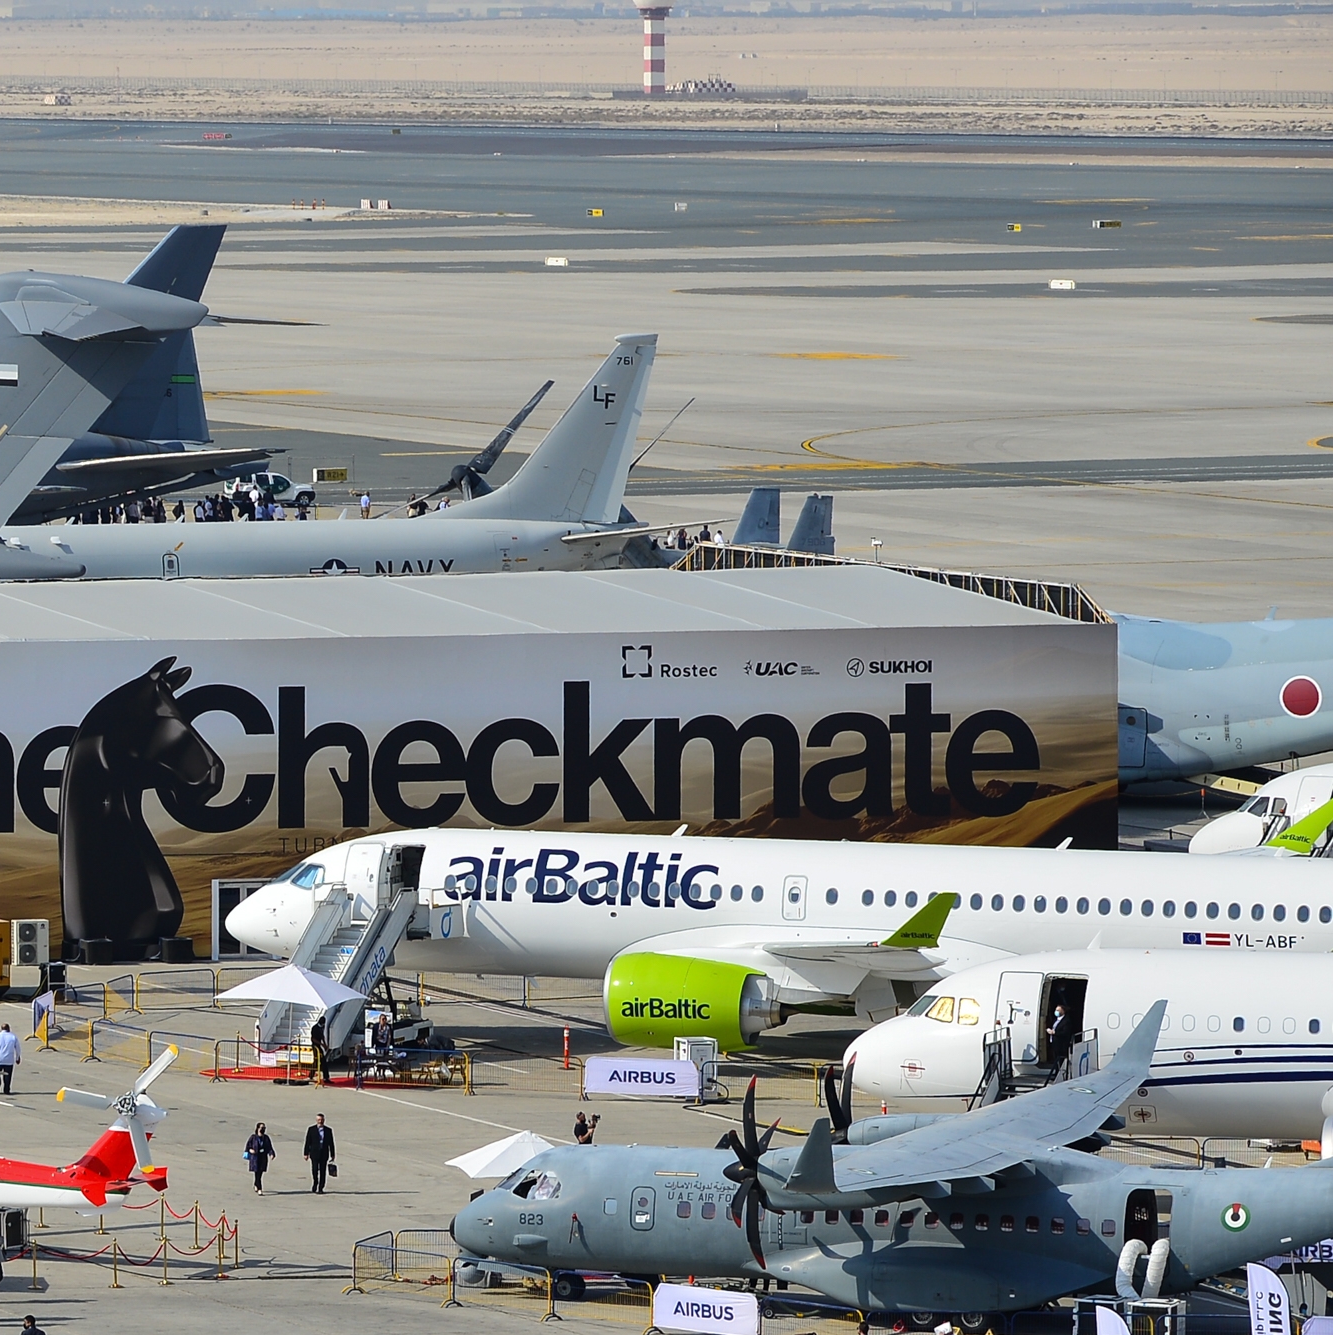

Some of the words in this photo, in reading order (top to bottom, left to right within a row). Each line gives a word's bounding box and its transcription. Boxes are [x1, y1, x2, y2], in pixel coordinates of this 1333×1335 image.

[616, 357, 634, 366] 761
[595, 386, 616, 409] LF
[375, 559, 454, 574] NAVY
[660, 664, 718, 679] Rostec
[755, 661, 798, 676] UAC
[869, 660, 933, 674] SUKHOI
[156, 680, 1040, 830] Checkmate
[1280, 832, 1311, 845] airBaltic
[446, 849, 719, 910] airBaltic
[900, 931, 935, 940] airBaltic
[1234, 934, 1297, 949] YL-ABF
[621, 997, 710, 1020] airBaltic
[609, 1069, 676, 1085] AIRBUS
[667, 1190, 694, 1201] UAE
[697, 1192, 715, 1202] AIR
[518, 1212, 544, 1226] 823
[673, 1301, 734, 1321] AIRBUS
